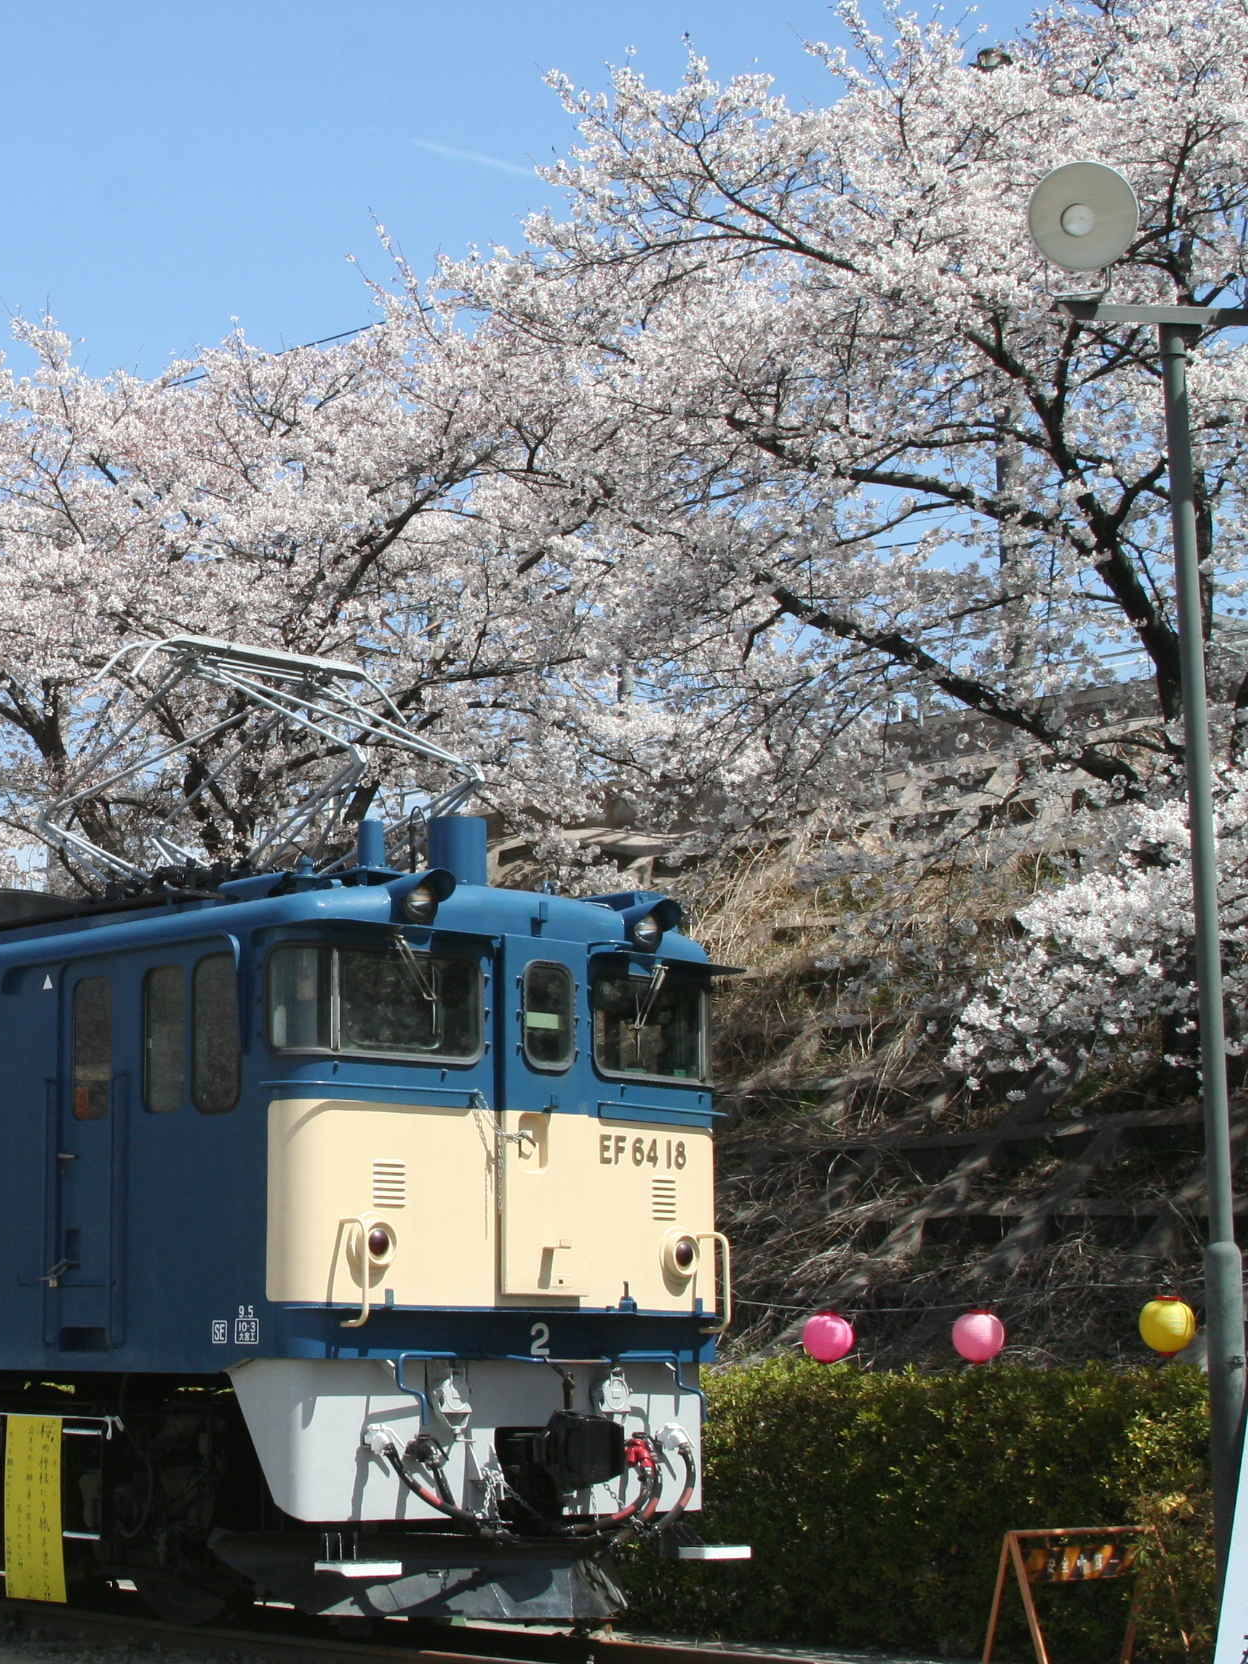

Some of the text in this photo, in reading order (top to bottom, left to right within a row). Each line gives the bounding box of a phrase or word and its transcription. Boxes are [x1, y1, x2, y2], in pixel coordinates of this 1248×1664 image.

[238, 1304, 254, 1318] 9.5
[214, 1323, 225, 1341] SE
[530, 1322, 550, 1356] 2
